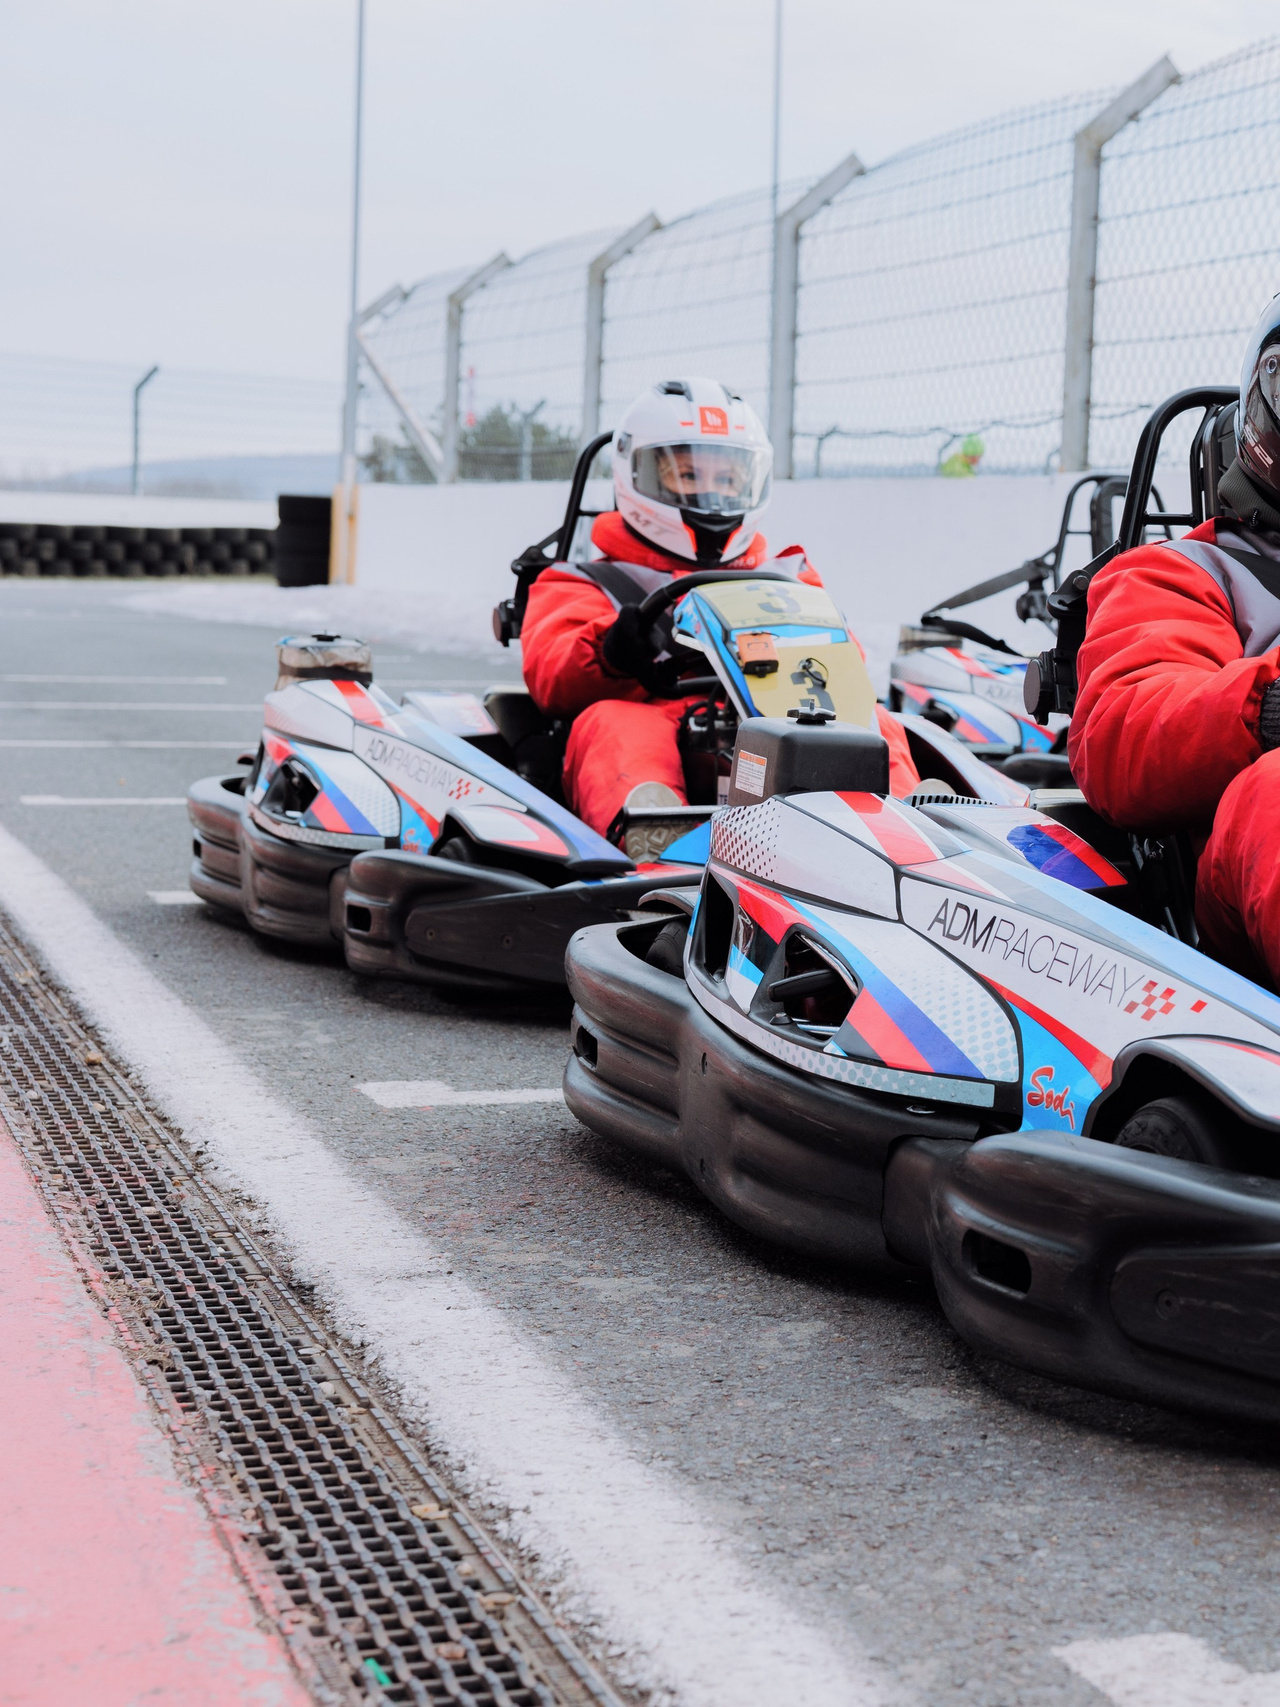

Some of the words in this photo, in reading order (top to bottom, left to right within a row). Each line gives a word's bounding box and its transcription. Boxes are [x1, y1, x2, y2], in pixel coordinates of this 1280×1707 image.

[629, 511, 677, 536] MT
[745, 583, 801, 614] 3
[790, 670, 836, 712] 3
[363, 737, 460, 794] ADMRACEWAY
[927, 897, 1146, 1008] ADMRACEWAY
[1026, 1066, 1076, 1130] Sodi
